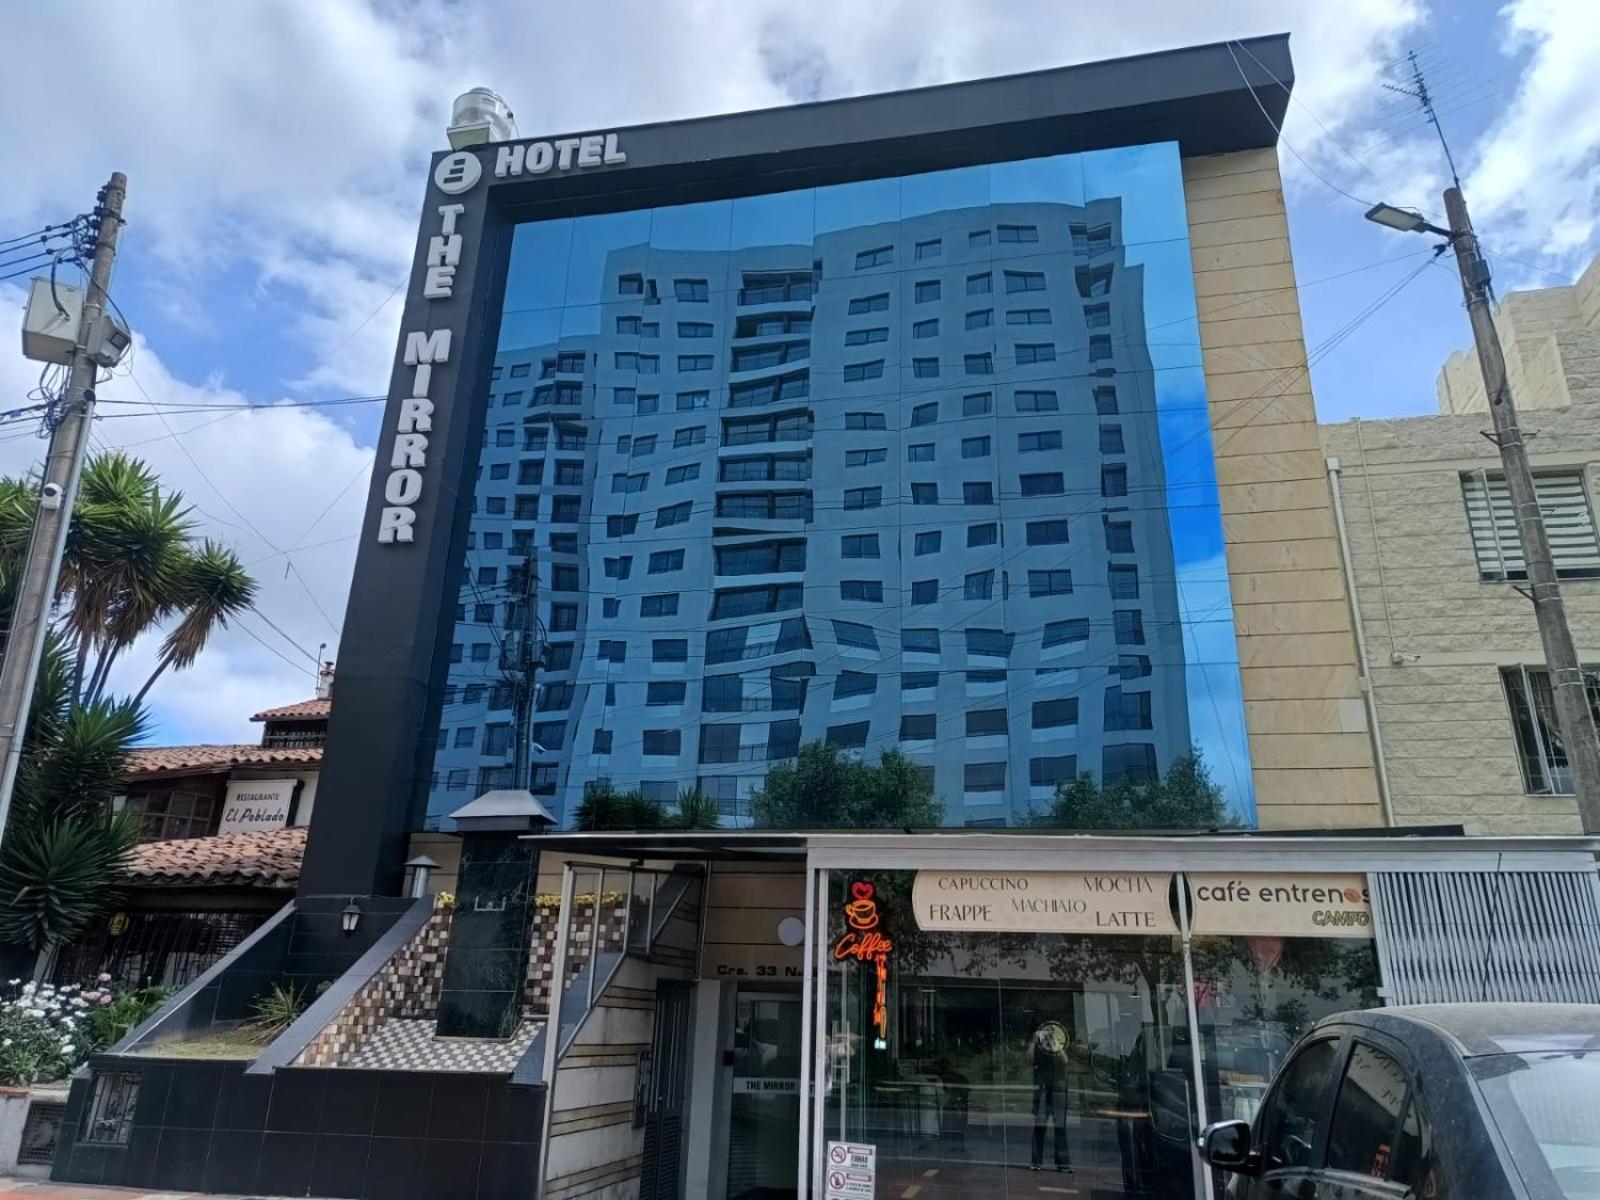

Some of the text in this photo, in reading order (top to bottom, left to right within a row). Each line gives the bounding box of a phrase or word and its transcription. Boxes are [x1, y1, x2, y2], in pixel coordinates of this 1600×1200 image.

[495, 133, 626, 178] HOTEL
[378, 203, 465, 544] THE MIRROR
[237, 793, 280, 801] RESTAURANTE
[225, 807, 285, 823] El Poblado
[938, 876, 1153, 893] CAPUCCINO MOCHA
[1197, 880, 1251, 902] café
[929, 904, 994, 922] FRAPPE
[1096, 911, 1156, 928] LATTE
[1312, 910, 1370, 927] CAMPO
[835, 933, 893, 960] Coffee
[756, 966, 777, 976] 33
[746, 1081, 796, 1091] THE MIRROR
